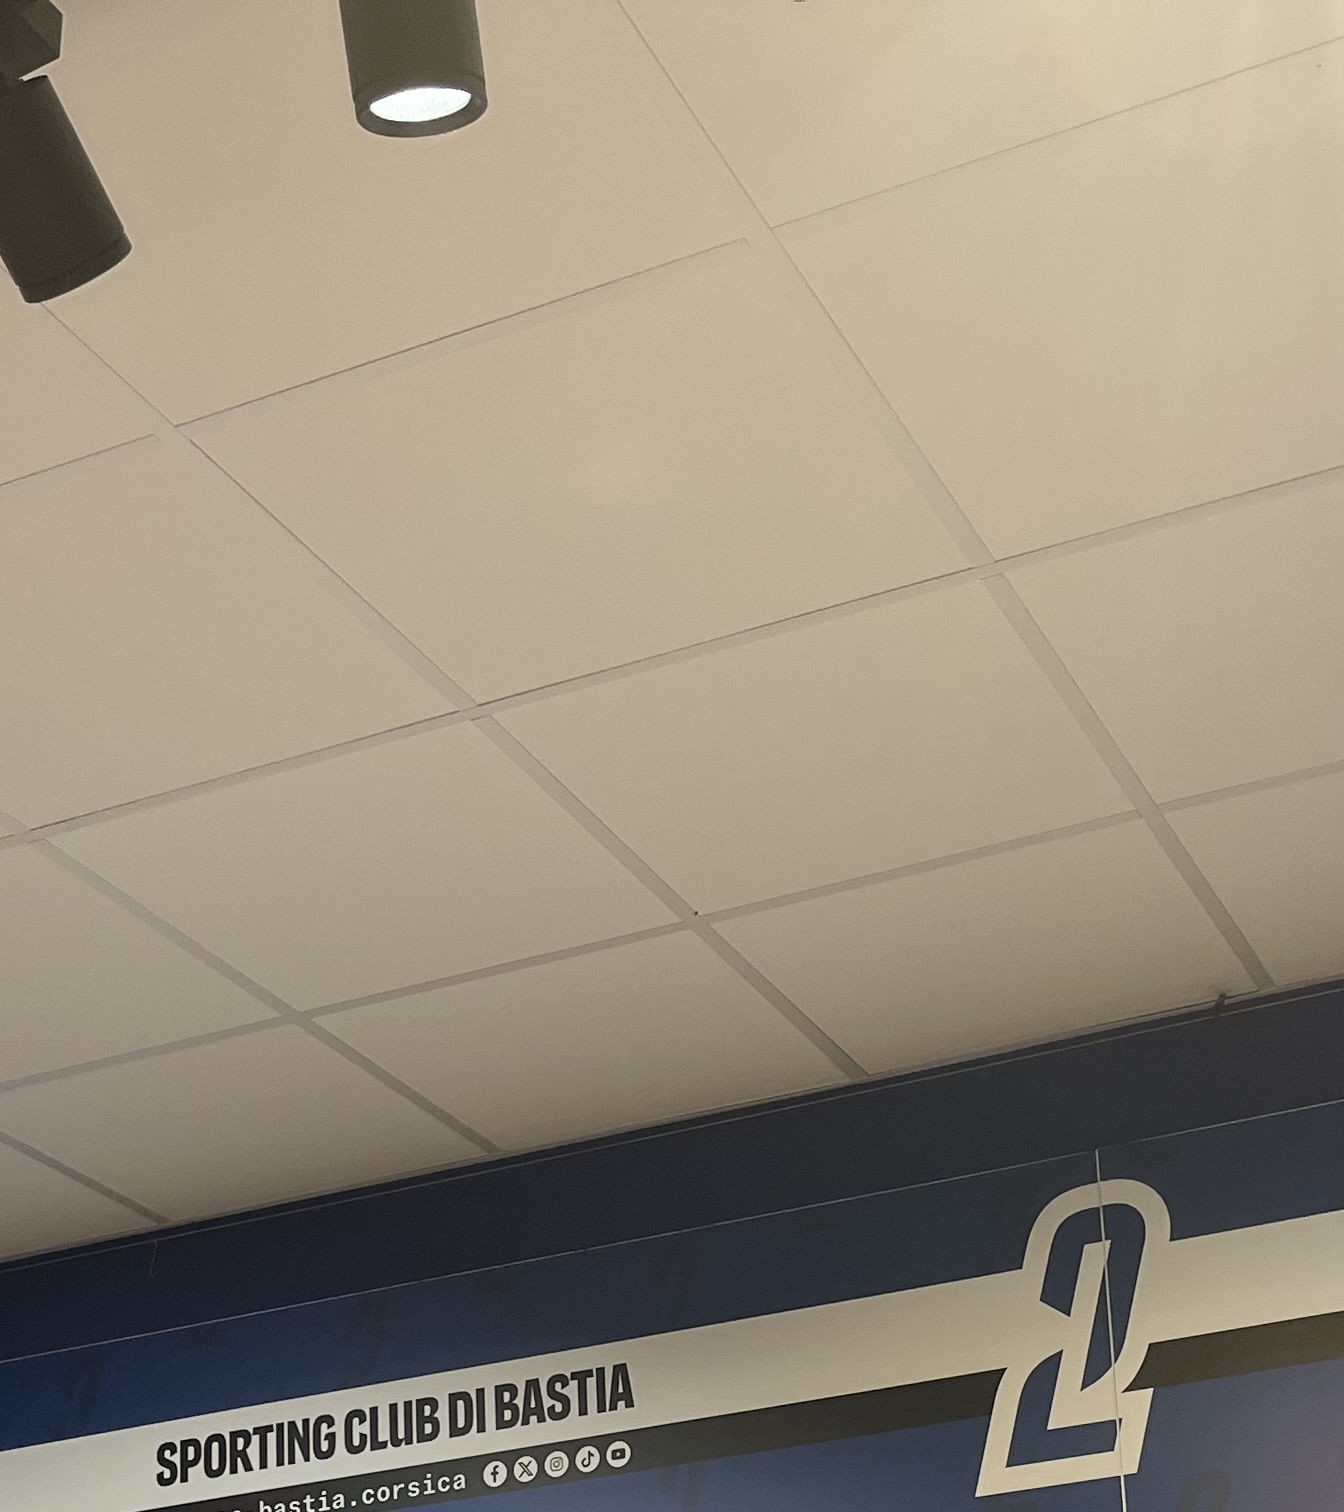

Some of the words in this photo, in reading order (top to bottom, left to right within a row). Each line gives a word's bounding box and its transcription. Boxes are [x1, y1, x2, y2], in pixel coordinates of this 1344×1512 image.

[156, 1414, 336, 1487] SPORTING
[344, 1396, 440, 1451] CLUB
[448, 1392, 484, 1438] DI
[494, 1363, 635, 1433] BASTIA
